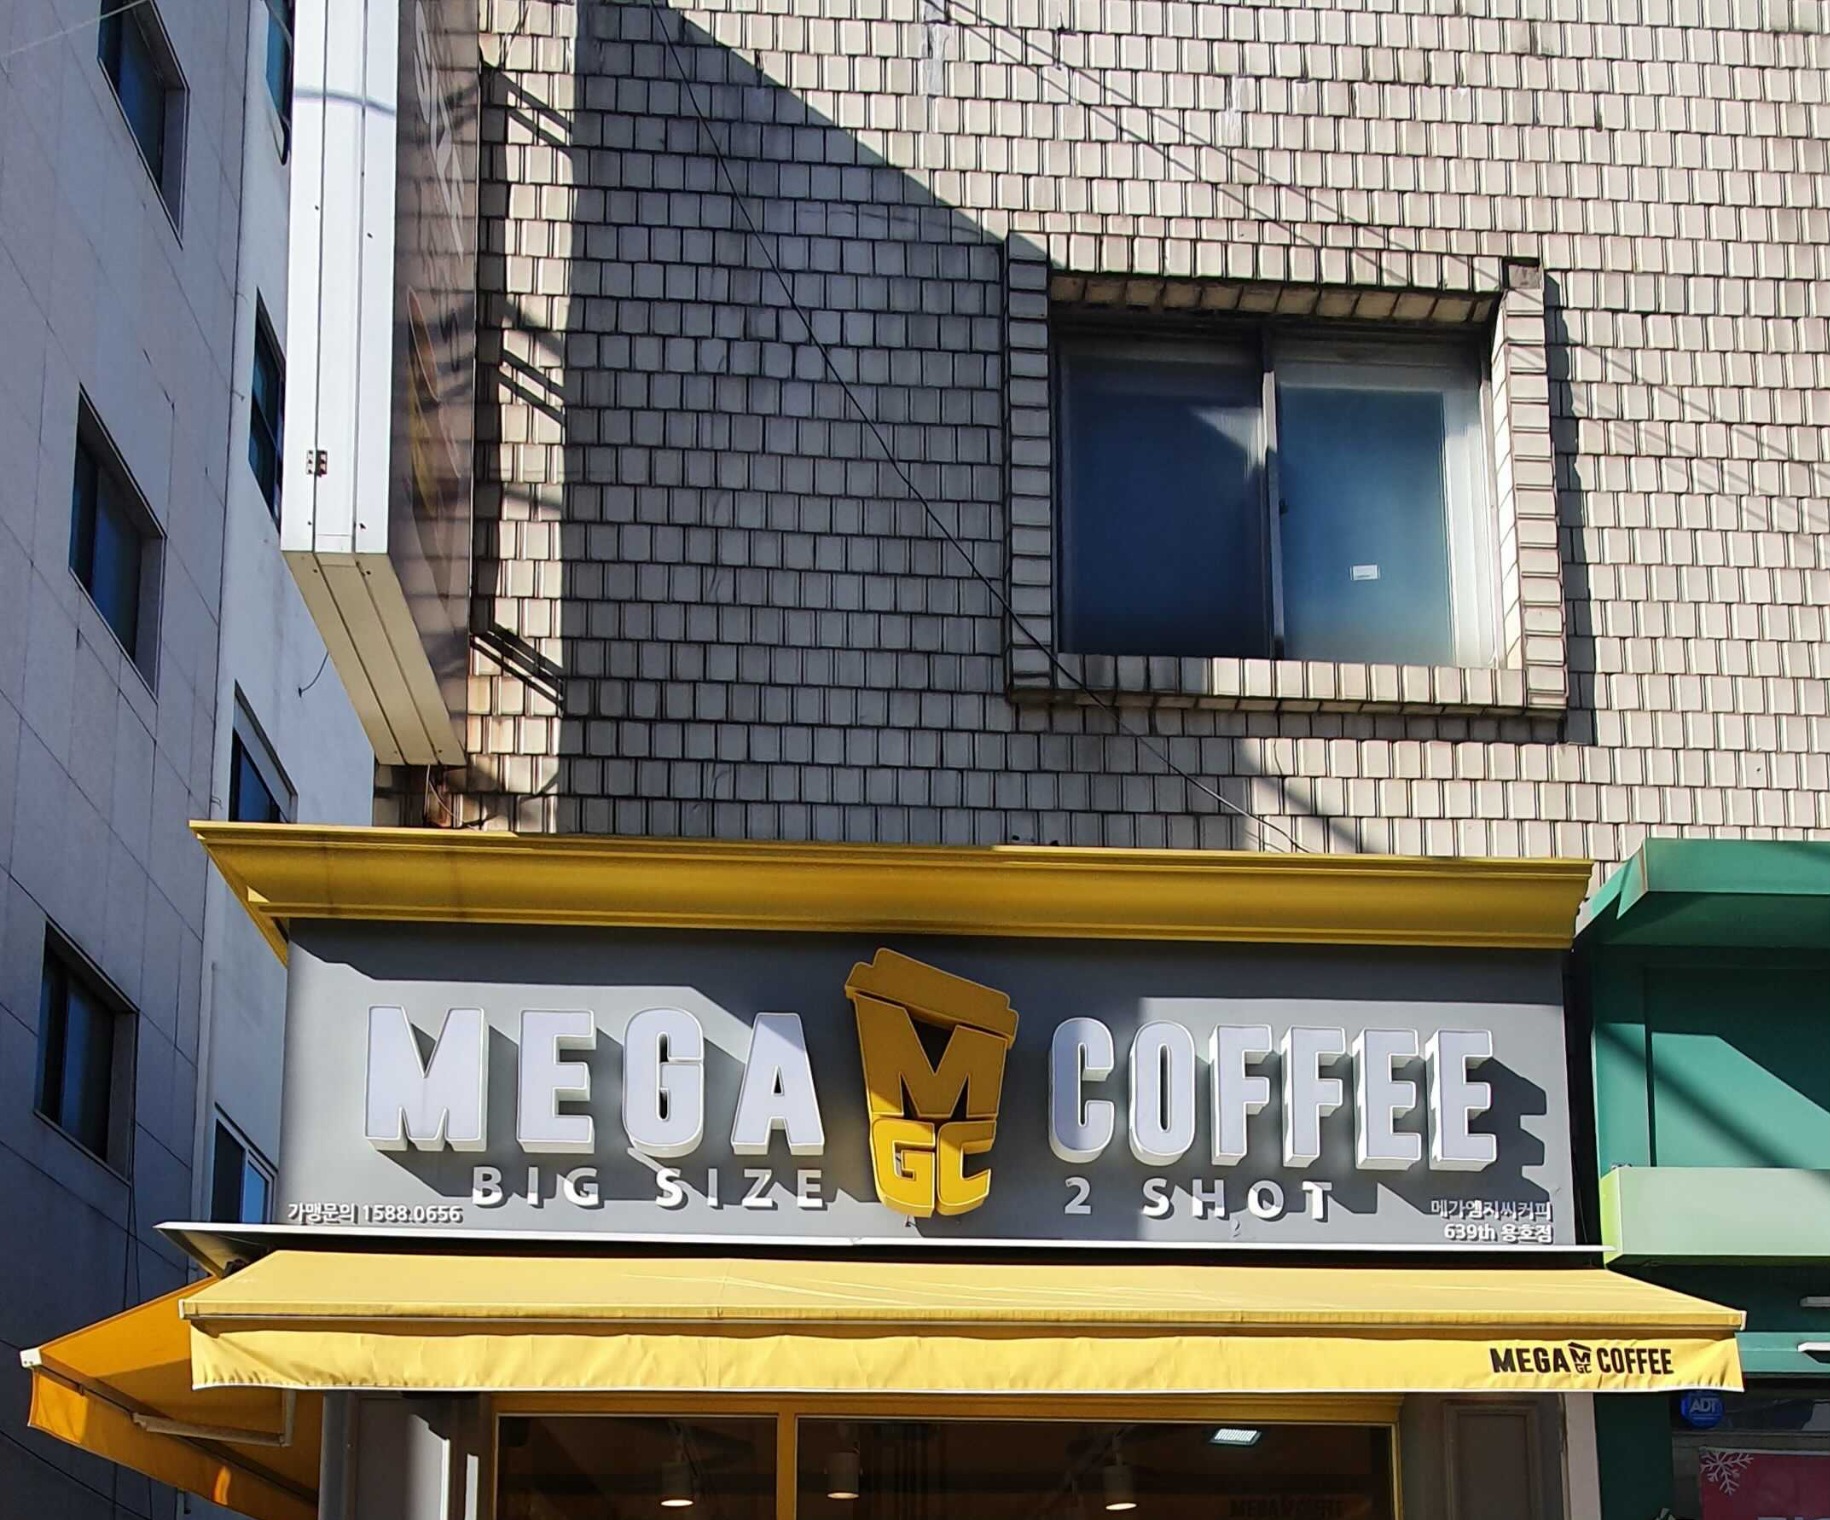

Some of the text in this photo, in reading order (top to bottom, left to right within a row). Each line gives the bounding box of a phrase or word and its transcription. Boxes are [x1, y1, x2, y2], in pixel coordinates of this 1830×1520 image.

[364, 1005, 1497, 1170] MEGA COFFEE
[471, 1166, 1334, 1221] BIG SIZE 2 SHOT
[287, 1202, 463, 1224] 가맹문의 1588.0656
[1431, 1199, 1553, 1222] 메가엠지씨커피
[1444, 1223, 1553, 1244] 639th 용호점
[1490, 1347, 1675, 1375] MEGA COFFEE
[1689, 1397, 1718, 1413] ADT
